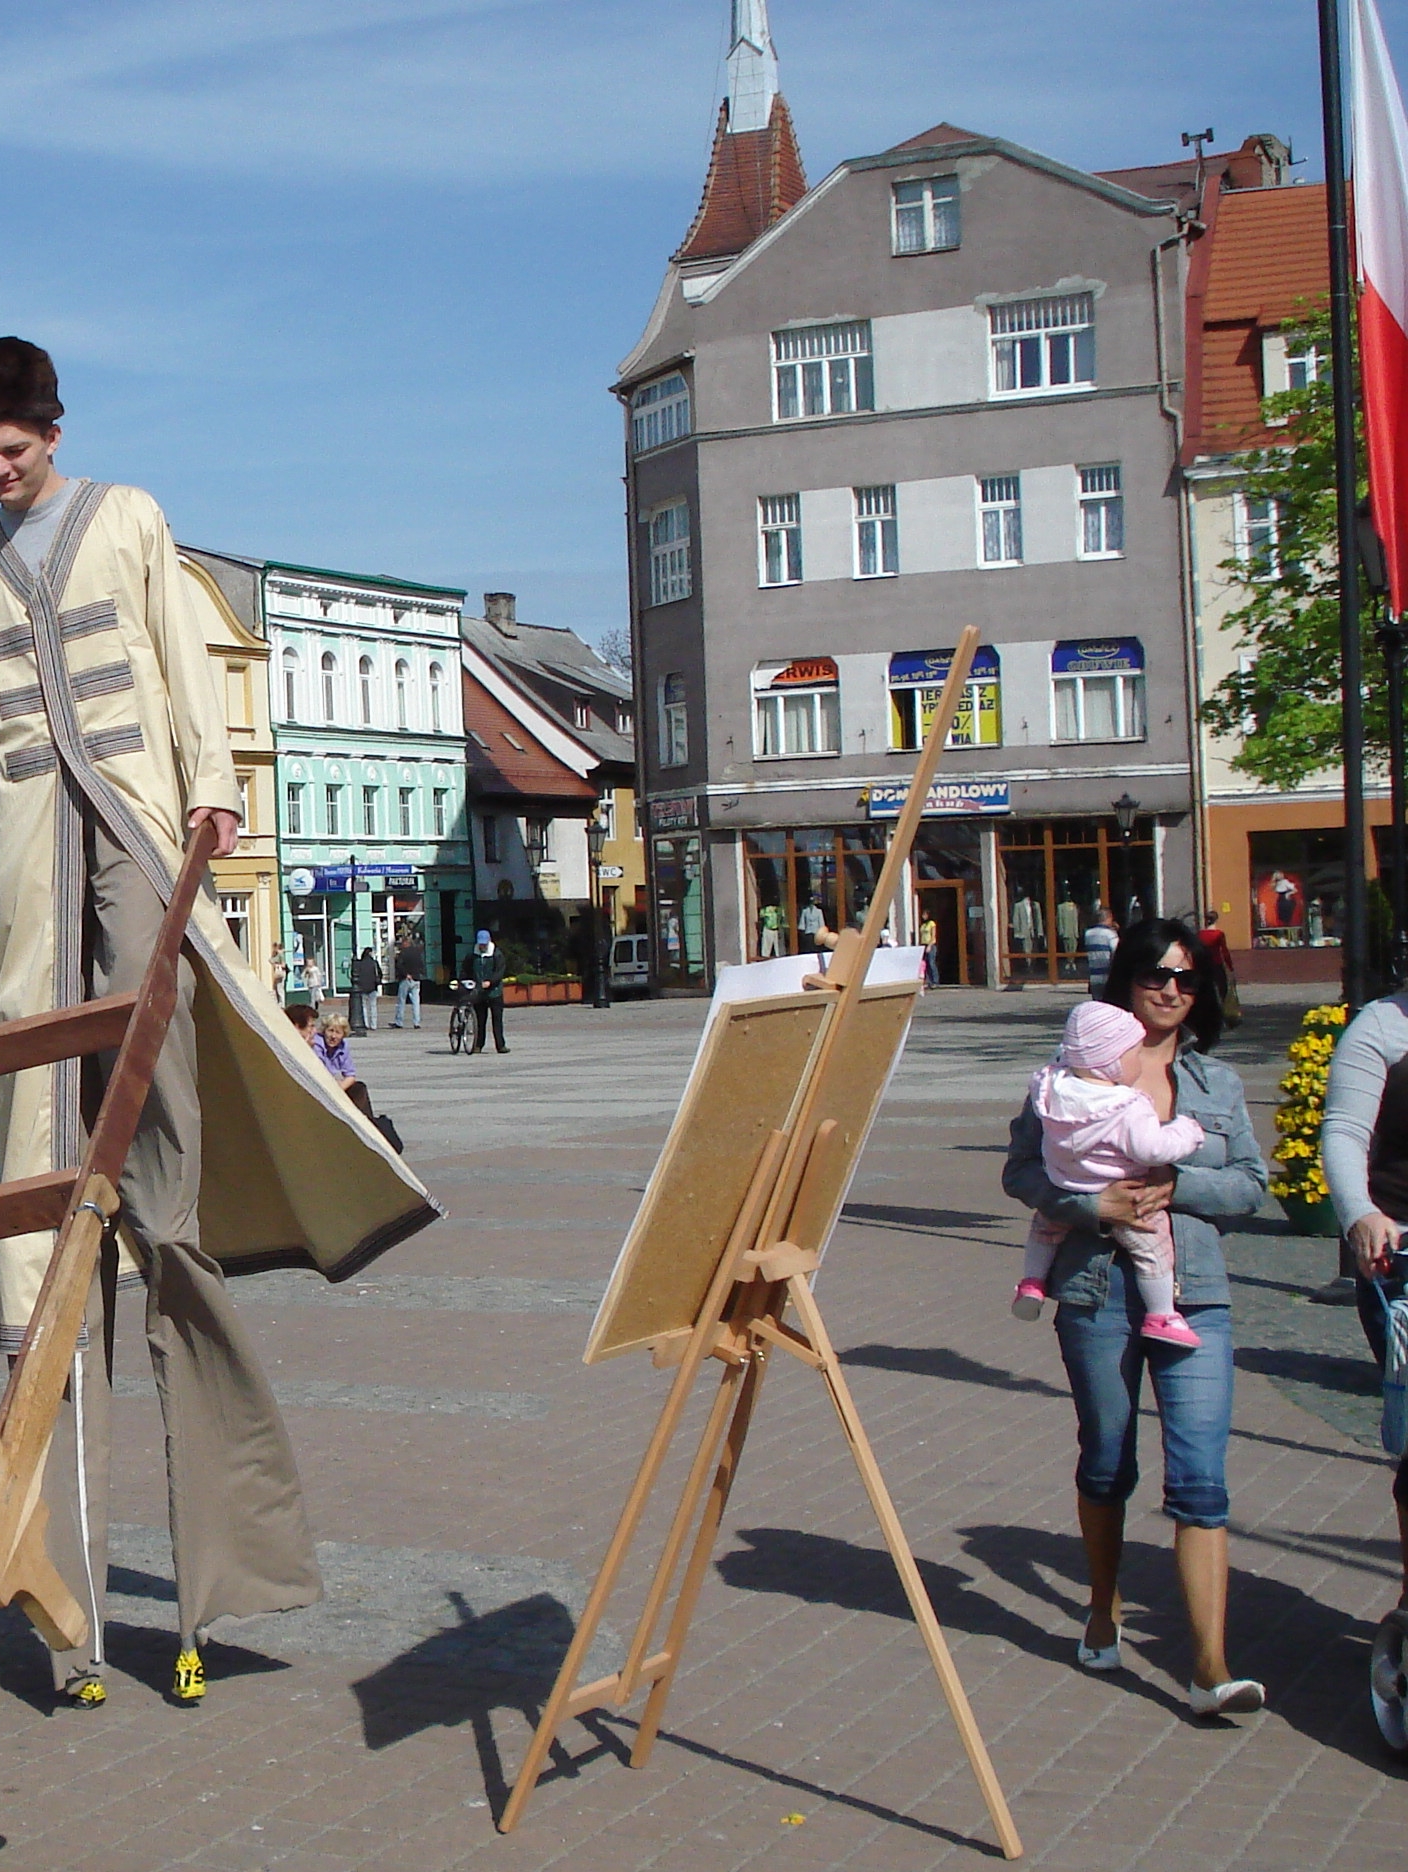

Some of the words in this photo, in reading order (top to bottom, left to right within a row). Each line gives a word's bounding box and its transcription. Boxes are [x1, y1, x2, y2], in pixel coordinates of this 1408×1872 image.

[773, 664, 833, 679] ERWIS
[925, 783, 1007, 799] ANDLOWY
[602, 867, 617, 877] WC
